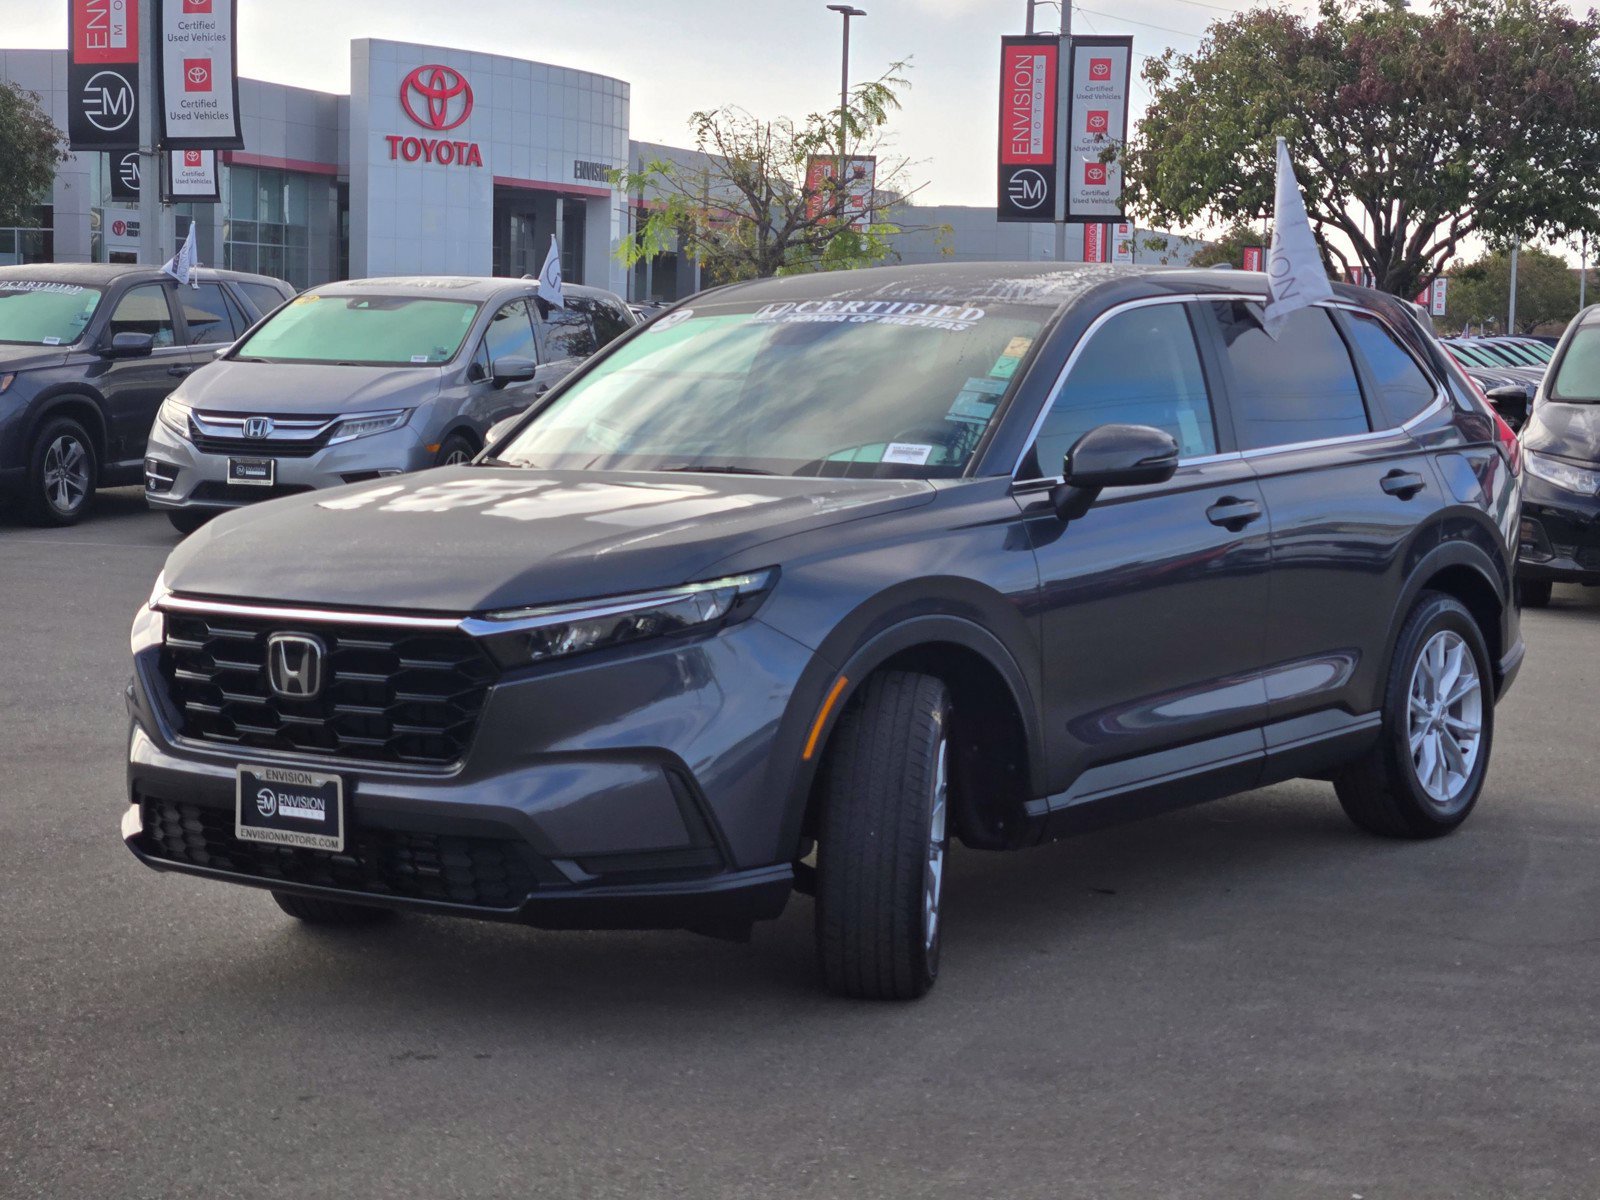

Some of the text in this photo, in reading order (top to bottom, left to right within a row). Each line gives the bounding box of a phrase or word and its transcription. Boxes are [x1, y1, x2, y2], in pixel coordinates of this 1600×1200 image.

[178, 20, 216, 30] Certified
[167, 33, 226, 42] Used Vehicles
[180, 98, 217, 108] Certified
[1012, 55, 1032, 154] ENVISION
[1033, 64, 1043, 146] MOTORS
[170, 111, 229, 120] Used Vehicles
[386, 135, 483, 168] TOYOTA
[795, 300, 985, 321] CERTIFIED
[265, 768, 312, 785] ENVISION
[278, 793, 325, 811] ENVISION
[241, 828, 339, 849] ENVISIONMOTORS.COM
